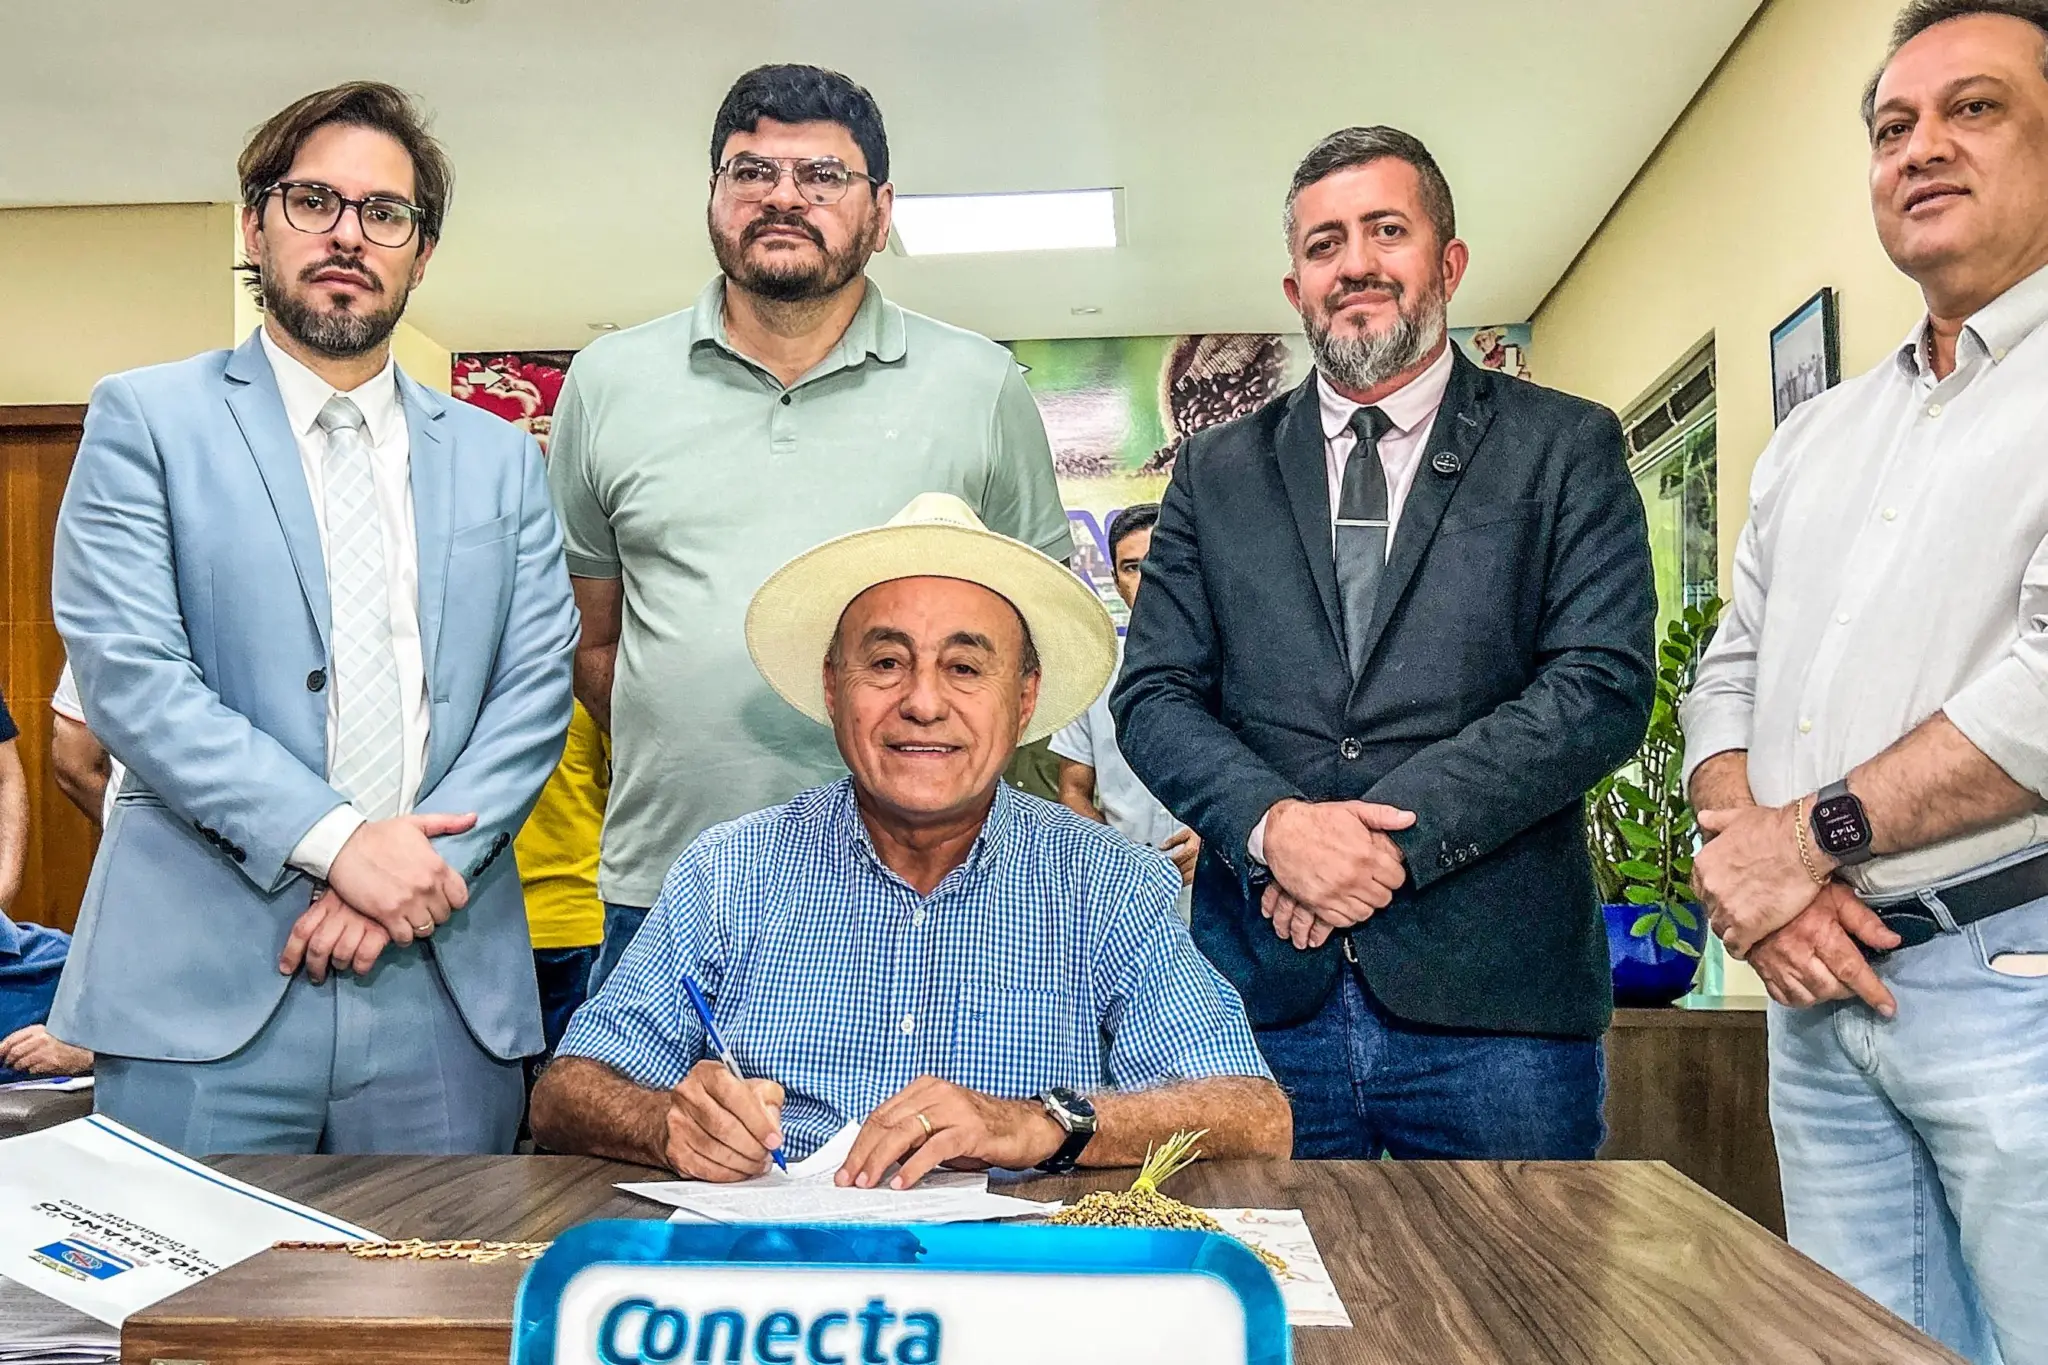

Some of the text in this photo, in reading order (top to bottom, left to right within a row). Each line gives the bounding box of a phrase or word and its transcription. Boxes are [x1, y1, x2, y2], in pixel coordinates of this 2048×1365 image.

[40, 1202, 162, 1255] BRANCO
[59, 1199, 133, 1232] EMPREGO
[102, 1212, 187, 1248] DIGNIDADE
[596, 1296, 943, 1365] Conecta
